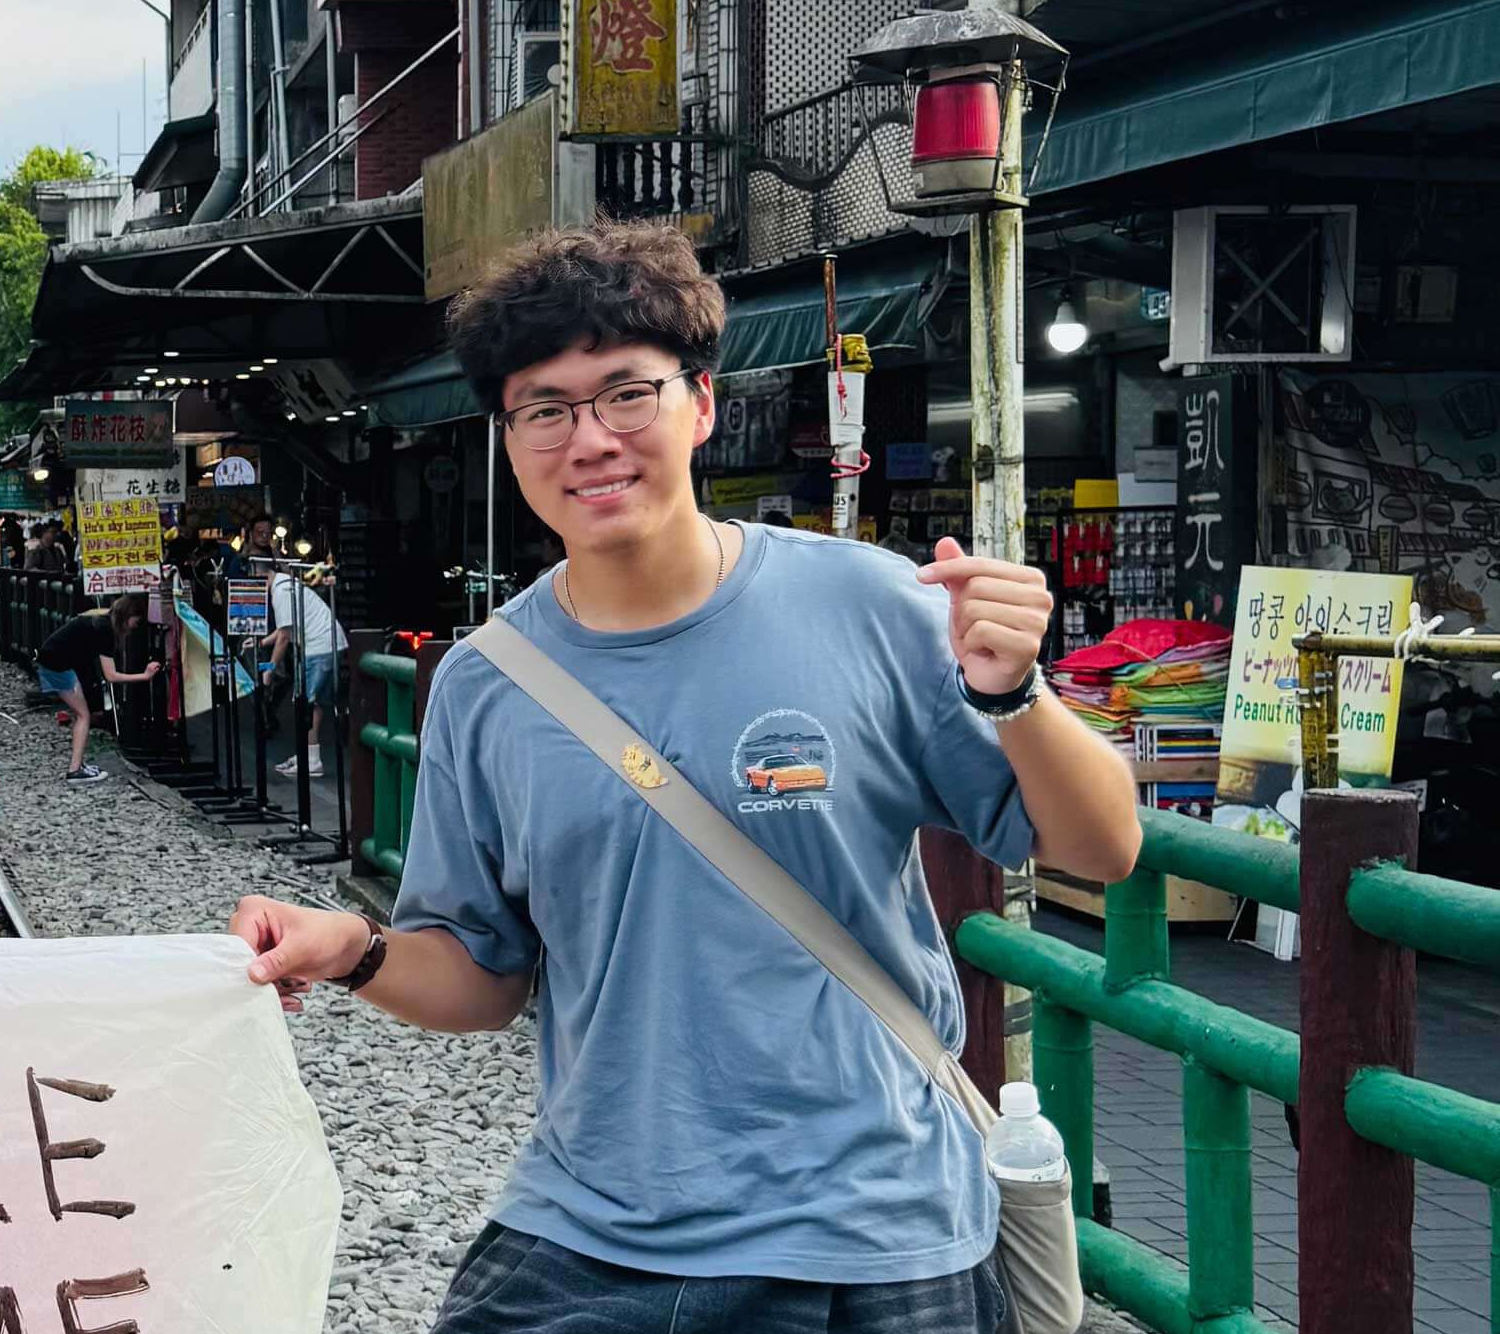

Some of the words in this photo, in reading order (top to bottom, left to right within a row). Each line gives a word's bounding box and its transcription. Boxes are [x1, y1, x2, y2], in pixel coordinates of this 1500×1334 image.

[1249, 592, 1285, 641] 땅콩
[1235, 694, 1281, 725] Peanut
[1341, 702, 1385, 733] Cream
[737, 799, 835, 814] CORVETTE
